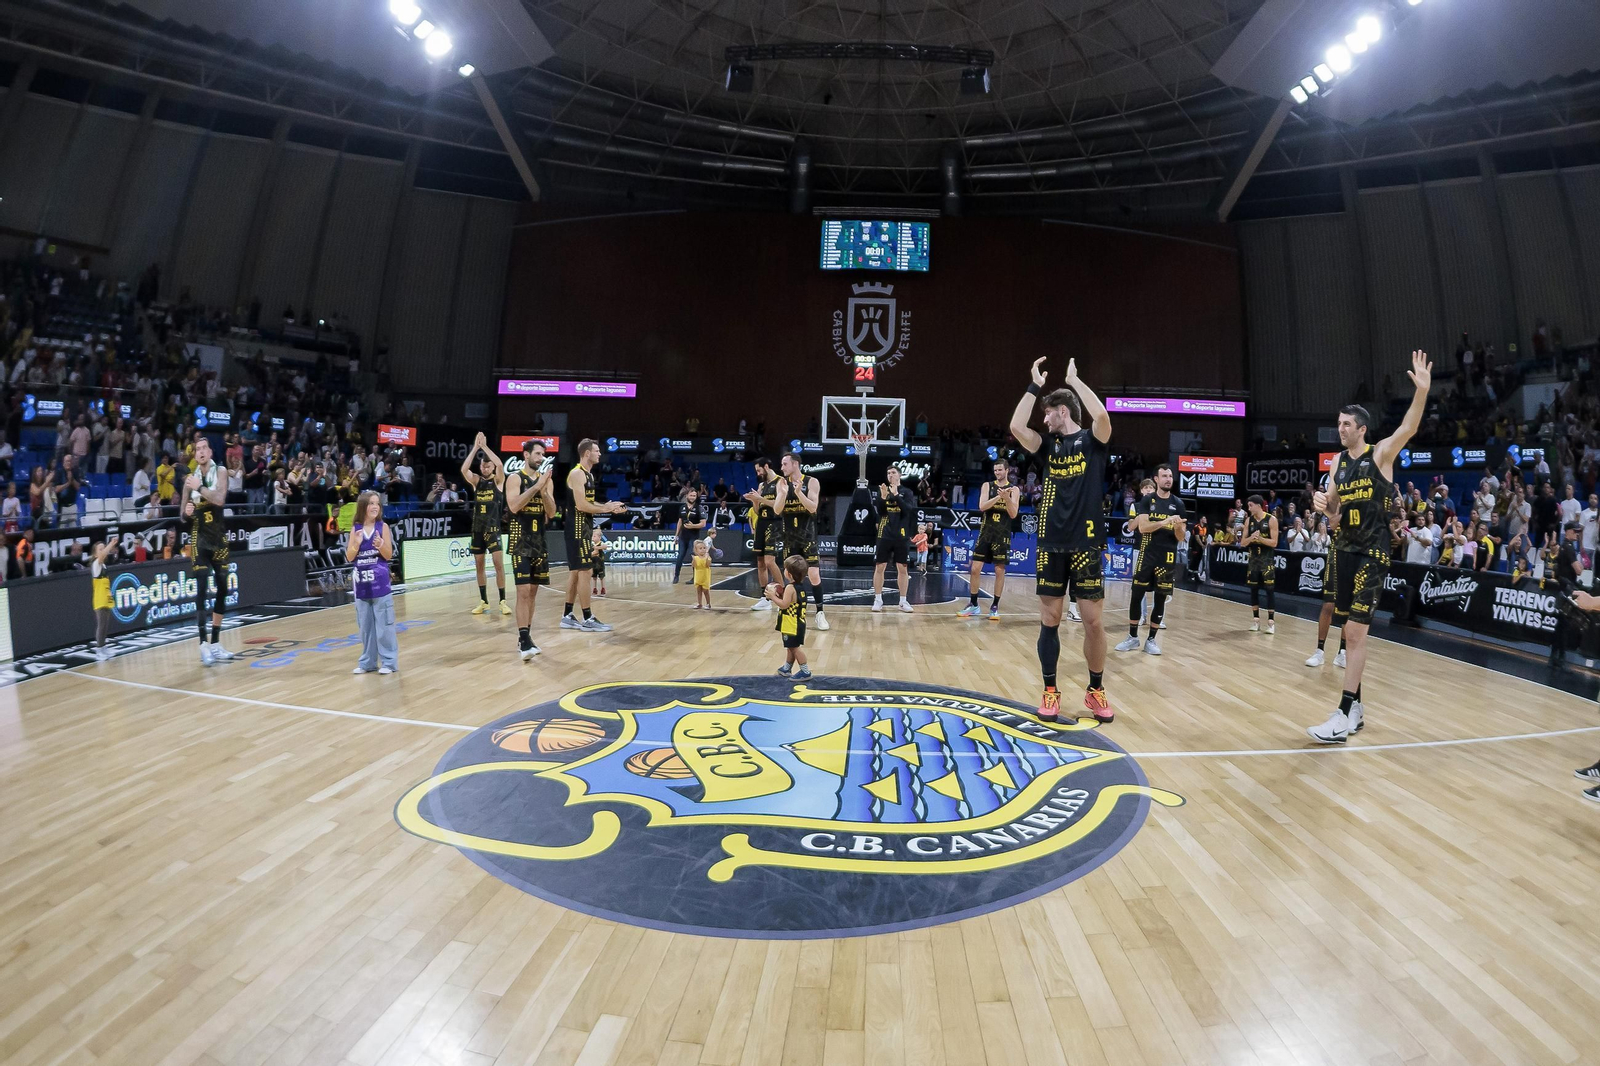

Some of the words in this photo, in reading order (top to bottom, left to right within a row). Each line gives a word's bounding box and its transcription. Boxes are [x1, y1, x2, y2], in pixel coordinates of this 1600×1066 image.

[877, 310, 912, 371] TENERIFE
[855, 366, 874, 380] 24
[1251, 469, 1309, 484] RECORD
[1349, 509, 1360, 525] 19
[532, 520, 538, 532] 6
[1086, 520, 1094, 538] 2
[602, 536, 679, 551] ediolanum
[610, 552, 633, 560] ¿Cuáles
[1166, 552, 1174, 563] 13
[362, 570, 374, 581] 35
[1419, 576, 1478, 605] Pantástico
[1495, 587, 1559, 614] TERRENO
[821, 695, 882, 703] TFE
[901, 695, 1018, 720] LAGUNA
[1016, 720, 1058, 737] LA
[683, 722, 763, 778] C.B.C.
[800, 832, 895, 855] C.B.
[906, 787, 1090, 855] CANARIAS
